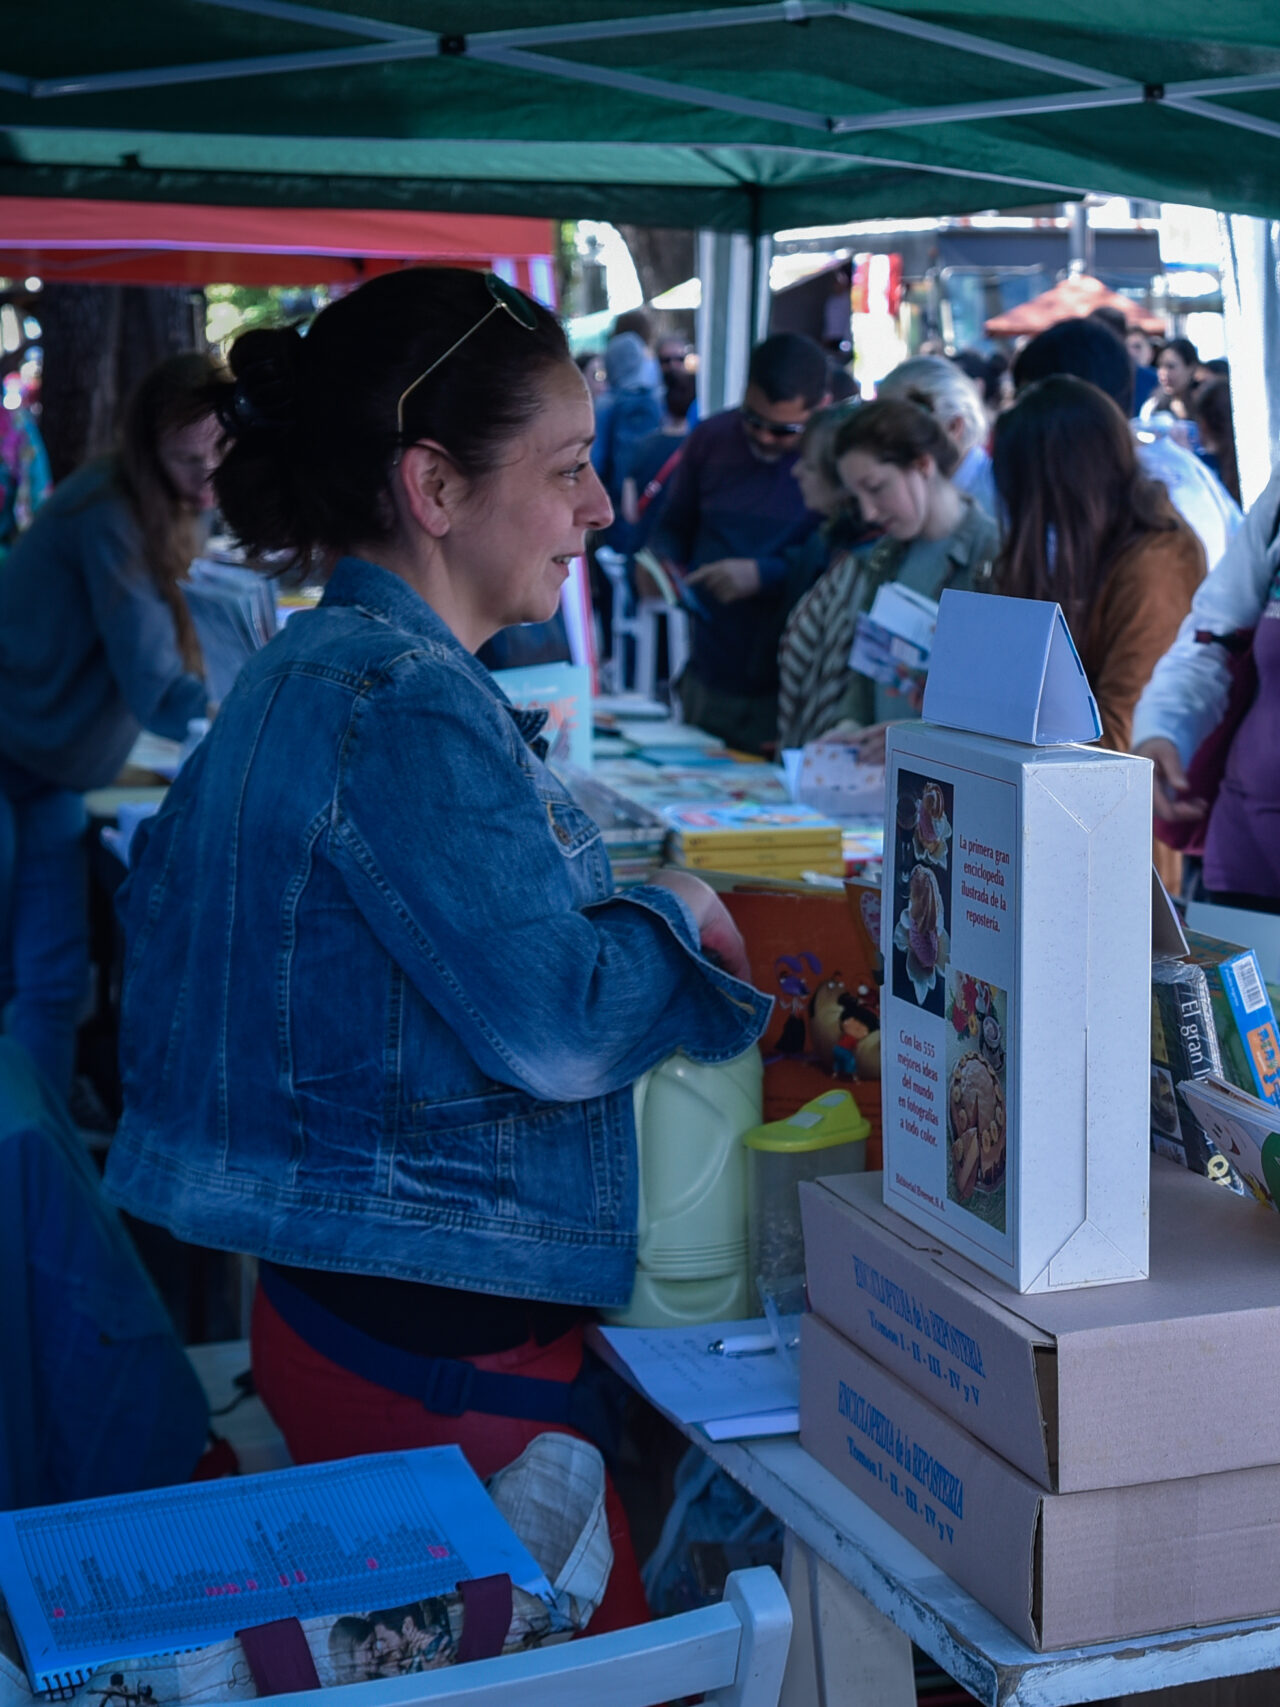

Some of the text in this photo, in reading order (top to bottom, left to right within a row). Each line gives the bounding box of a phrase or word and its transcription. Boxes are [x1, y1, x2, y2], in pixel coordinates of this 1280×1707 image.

[960, 834, 1009, 865] La primera gran
[963, 862, 1005, 887] enciclopedia
[961, 880, 1006, 911] ilustrada de la
[1181, 1000, 1201, 1017] El
[900, 1030, 935, 1058] Con las 555
[1181, 1023, 1203, 1064] gran
[897, 1053, 938, 1082] mejores ideas
[902, 1073, 934, 1101] del mundo
[898, 1096, 939, 1126] en fotografías
[900, 1118, 937, 1147] a todo color.
[868, 1309, 899, 1346] Tomos
[912, 1341, 921, 1364] II
[928, 1353, 943, 1379] III
[949, 1367, 961, 1392] IV
[963, 1384, 970, 1403] y
[971, 1384, 980, 1407] V
[838, 1379, 964, 1520] ENCICLOPEDIA de la REPOSTERIA
[847, 1435, 878, 1477] Tomos
[890, 1471, 898, 1496] II
[905, 1485, 918, 1514] III
[924, 1503, 936, 1528] IV
[938, 1521, 944, 1541] y
[946, 1523, 954, 1544] V
